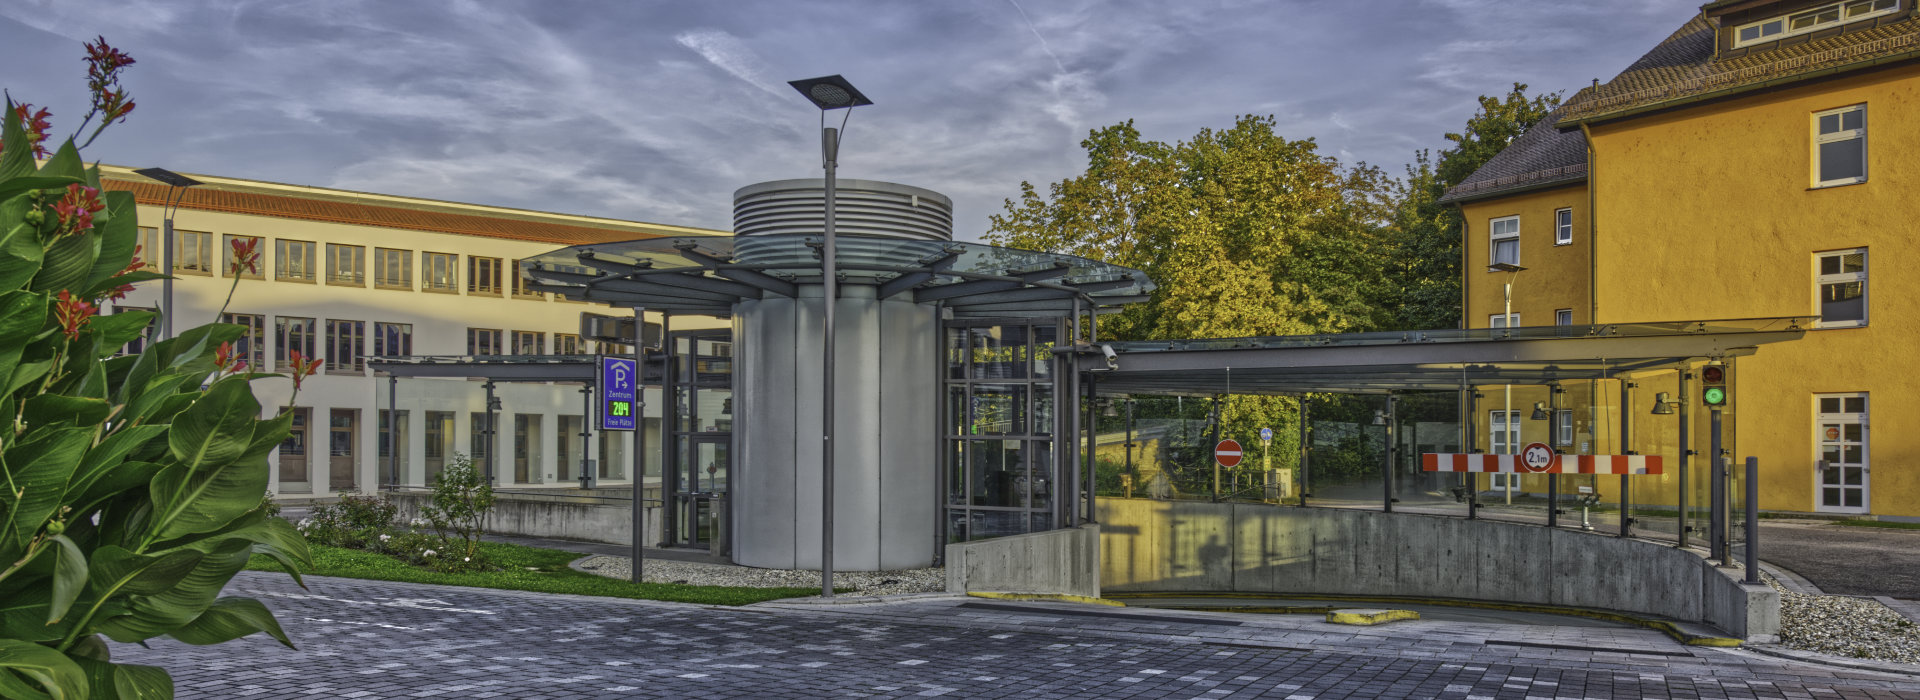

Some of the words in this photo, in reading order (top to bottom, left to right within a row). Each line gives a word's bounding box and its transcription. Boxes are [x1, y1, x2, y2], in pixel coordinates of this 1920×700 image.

[615, 368, 626, 389] P
[608, 390, 632, 399] Zentrum
[613, 401, 629, 416] 204
[607, 418, 619, 426] Freie
